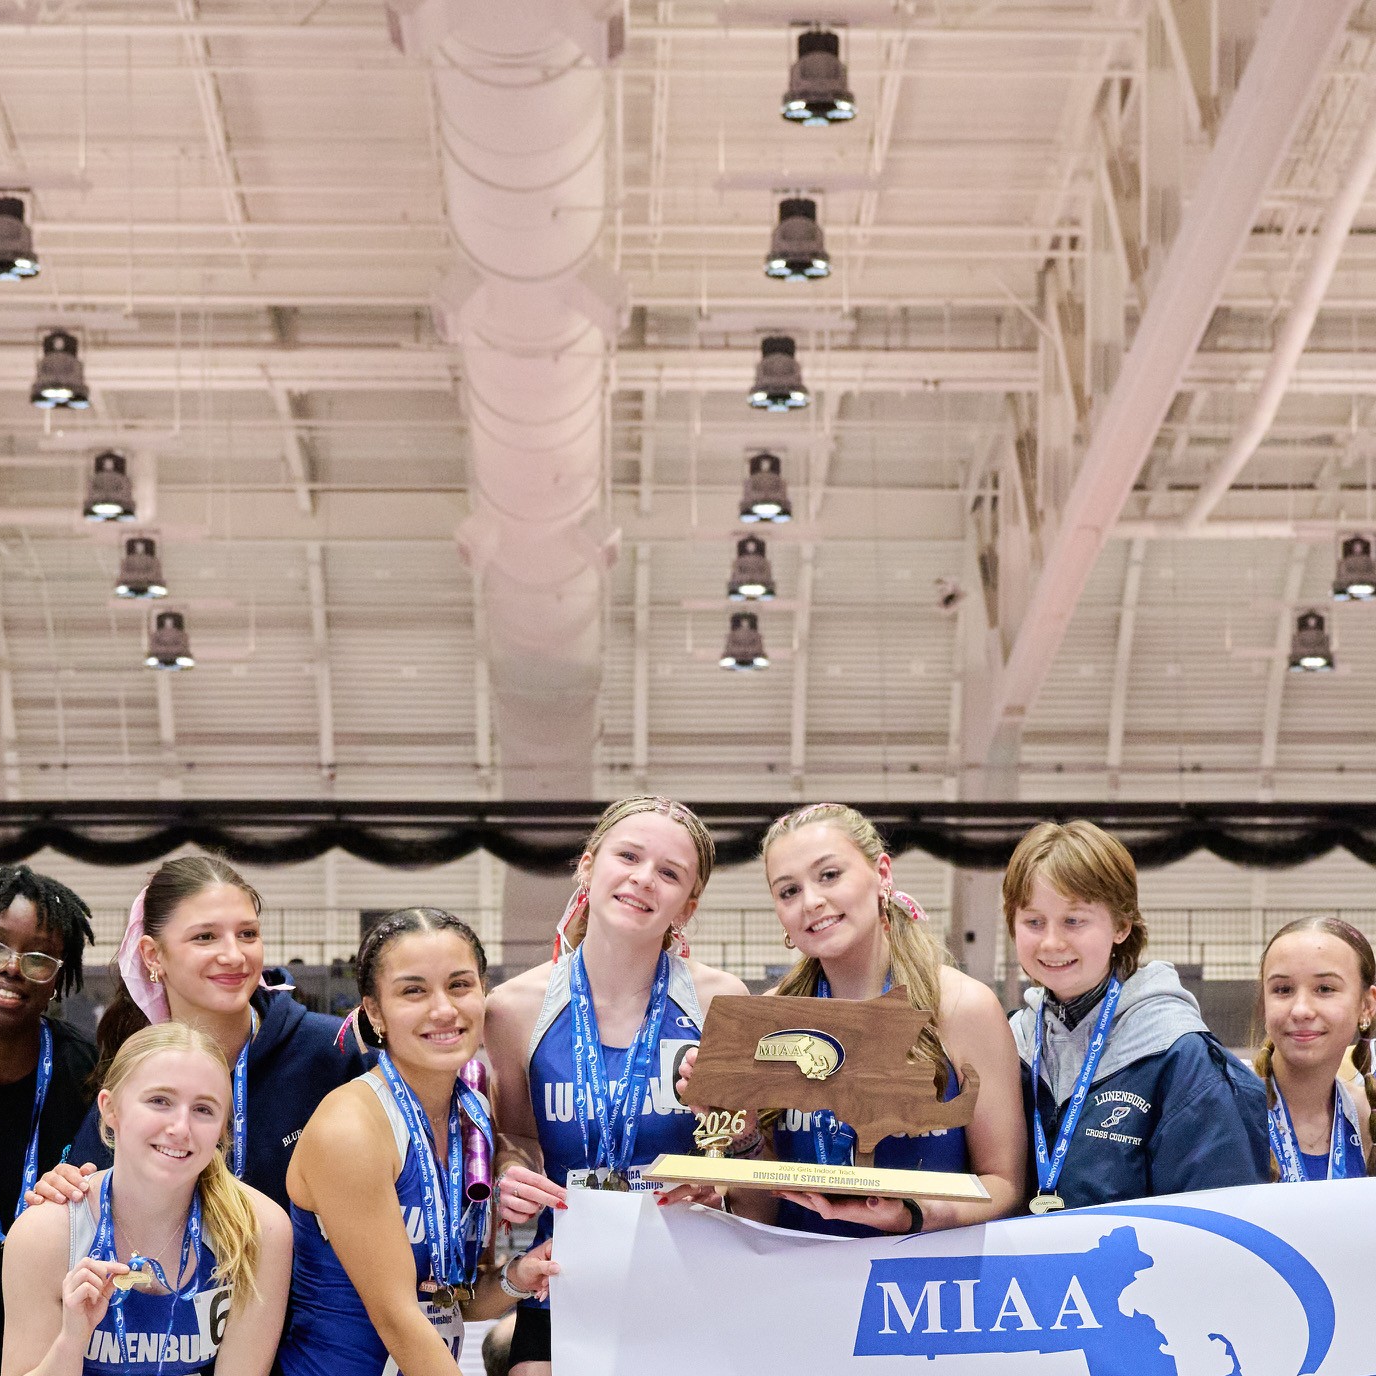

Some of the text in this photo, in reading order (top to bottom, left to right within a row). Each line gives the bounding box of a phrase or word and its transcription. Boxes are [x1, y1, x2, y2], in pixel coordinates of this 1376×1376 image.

[758, 1044, 804, 1058] MIAA
[1094, 1090, 1151, 1114] LUNENBURG
[692, 1110, 747, 1134] 2026
[1085, 1128, 1143, 1146] CROSS COUNTRY
[753, 1172, 791, 1181] DIVISION
[801, 1175, 826, 1184] STATE
[828, 1177, 881, 1188] CHAMPIONS
[876, 1274, 1104, 1335] MIAA
